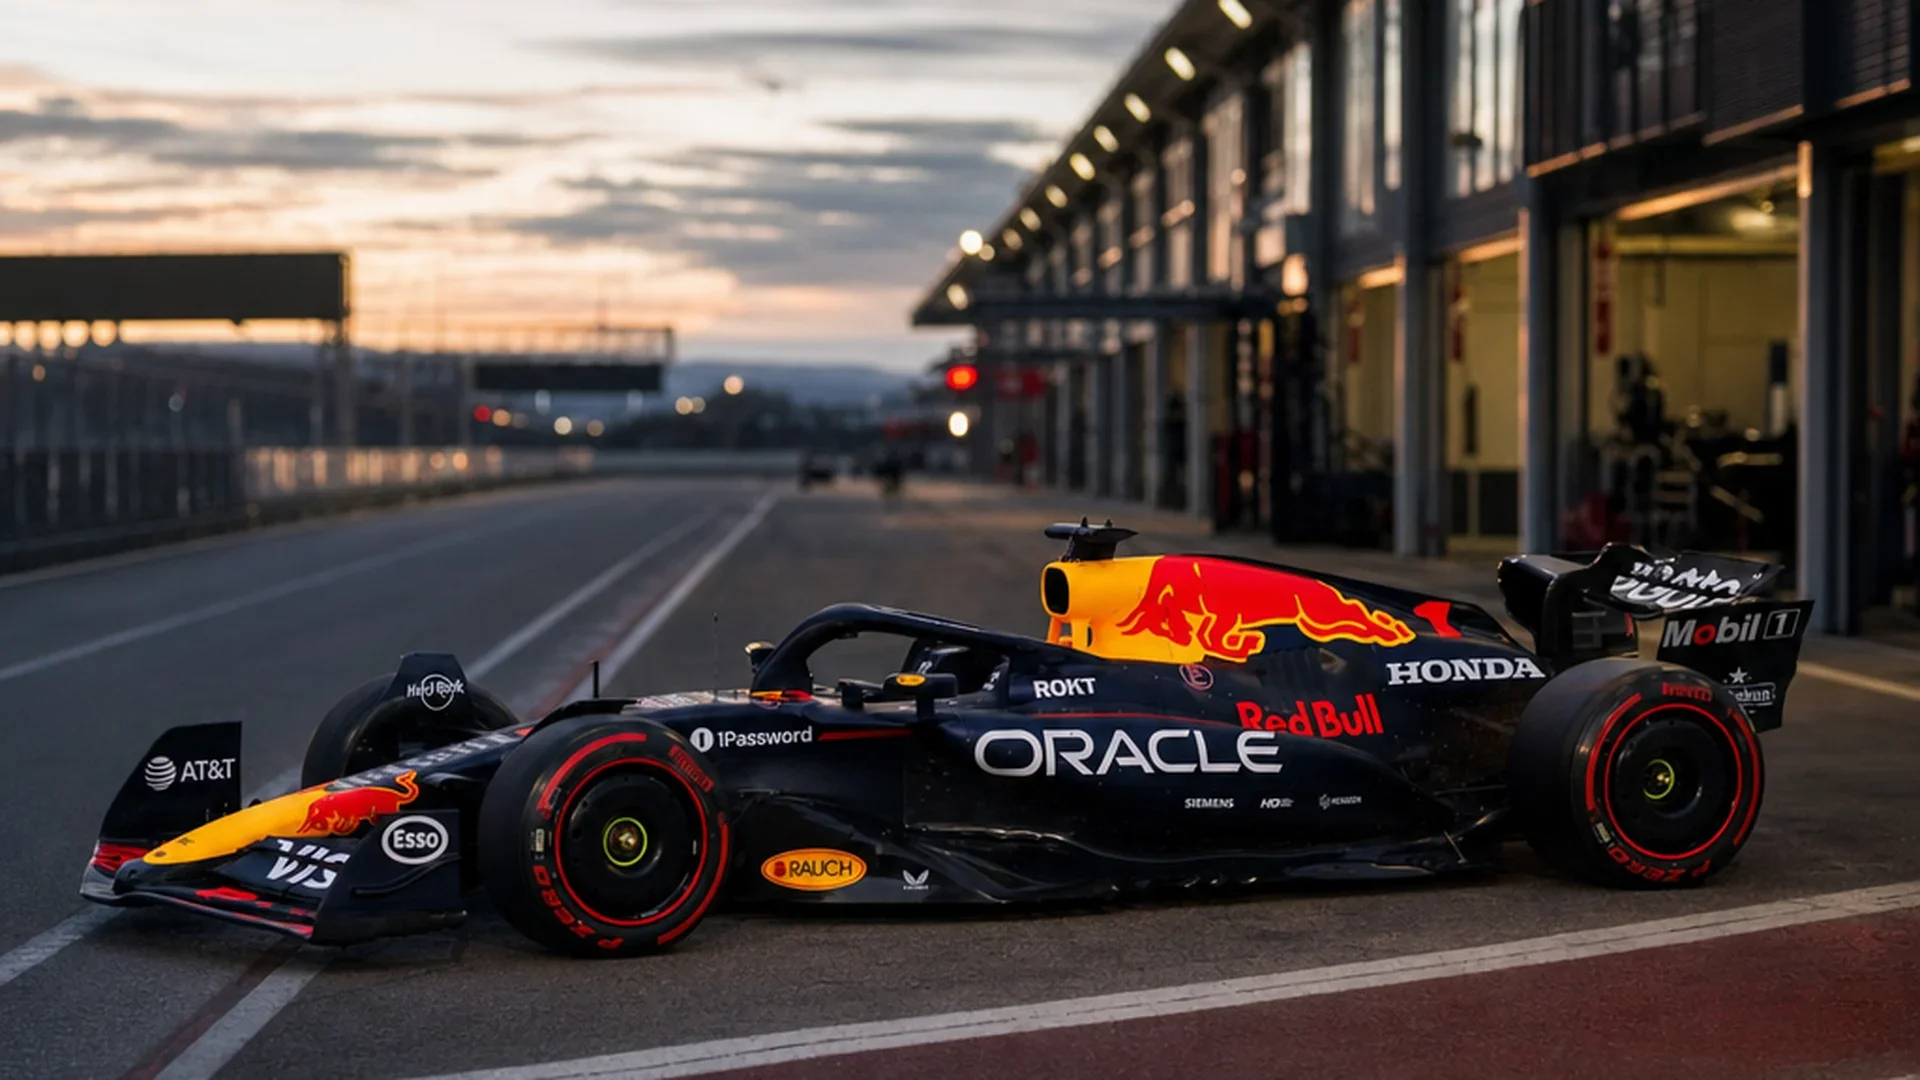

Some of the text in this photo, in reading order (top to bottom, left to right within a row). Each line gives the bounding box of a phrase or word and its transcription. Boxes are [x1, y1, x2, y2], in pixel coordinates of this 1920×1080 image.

[1662, 612, 1762, 648] Mobil
[1386, 657, 1546, 685] HONDA
[1033, 677, 1096, 699] ROKT
[1236, 693, 1384, 738] Red Bull
[717, 726, 812, 748] 1Password
[974, 728, 1285, 777] ORACLE
[180, 758, 236, 783] AT&T
[1184, 797, 1235, 809] SIEMENS
[789, 859, 853, 877] RAUCH
